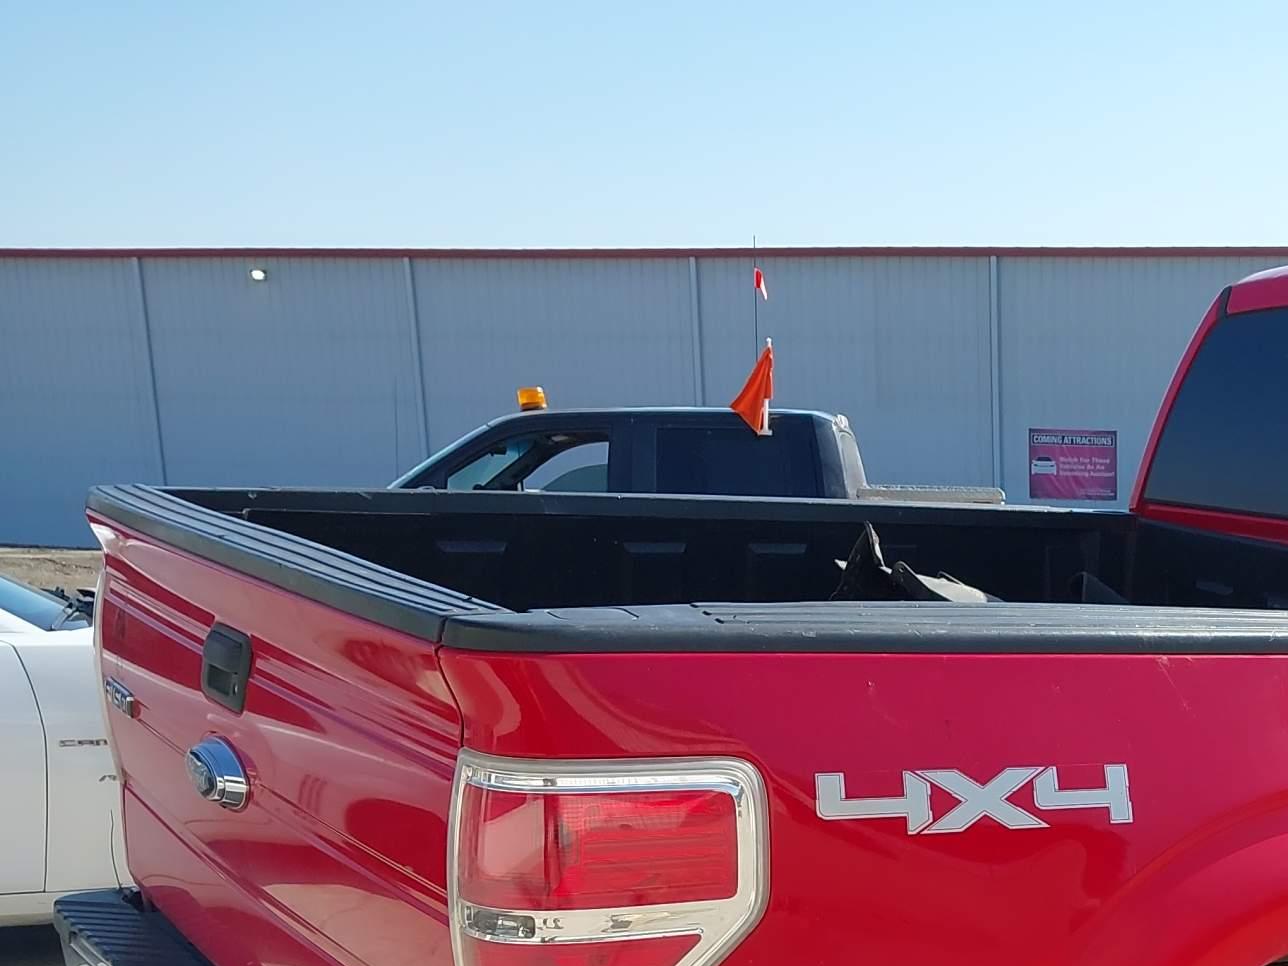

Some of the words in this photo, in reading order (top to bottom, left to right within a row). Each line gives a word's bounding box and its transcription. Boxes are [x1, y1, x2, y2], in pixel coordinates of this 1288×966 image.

[1033, 434, 1061, 444] COMING
[1063, 435, 1112, 446] ATTRACTIONS
[814, 763, 1134, 836] 4X4
